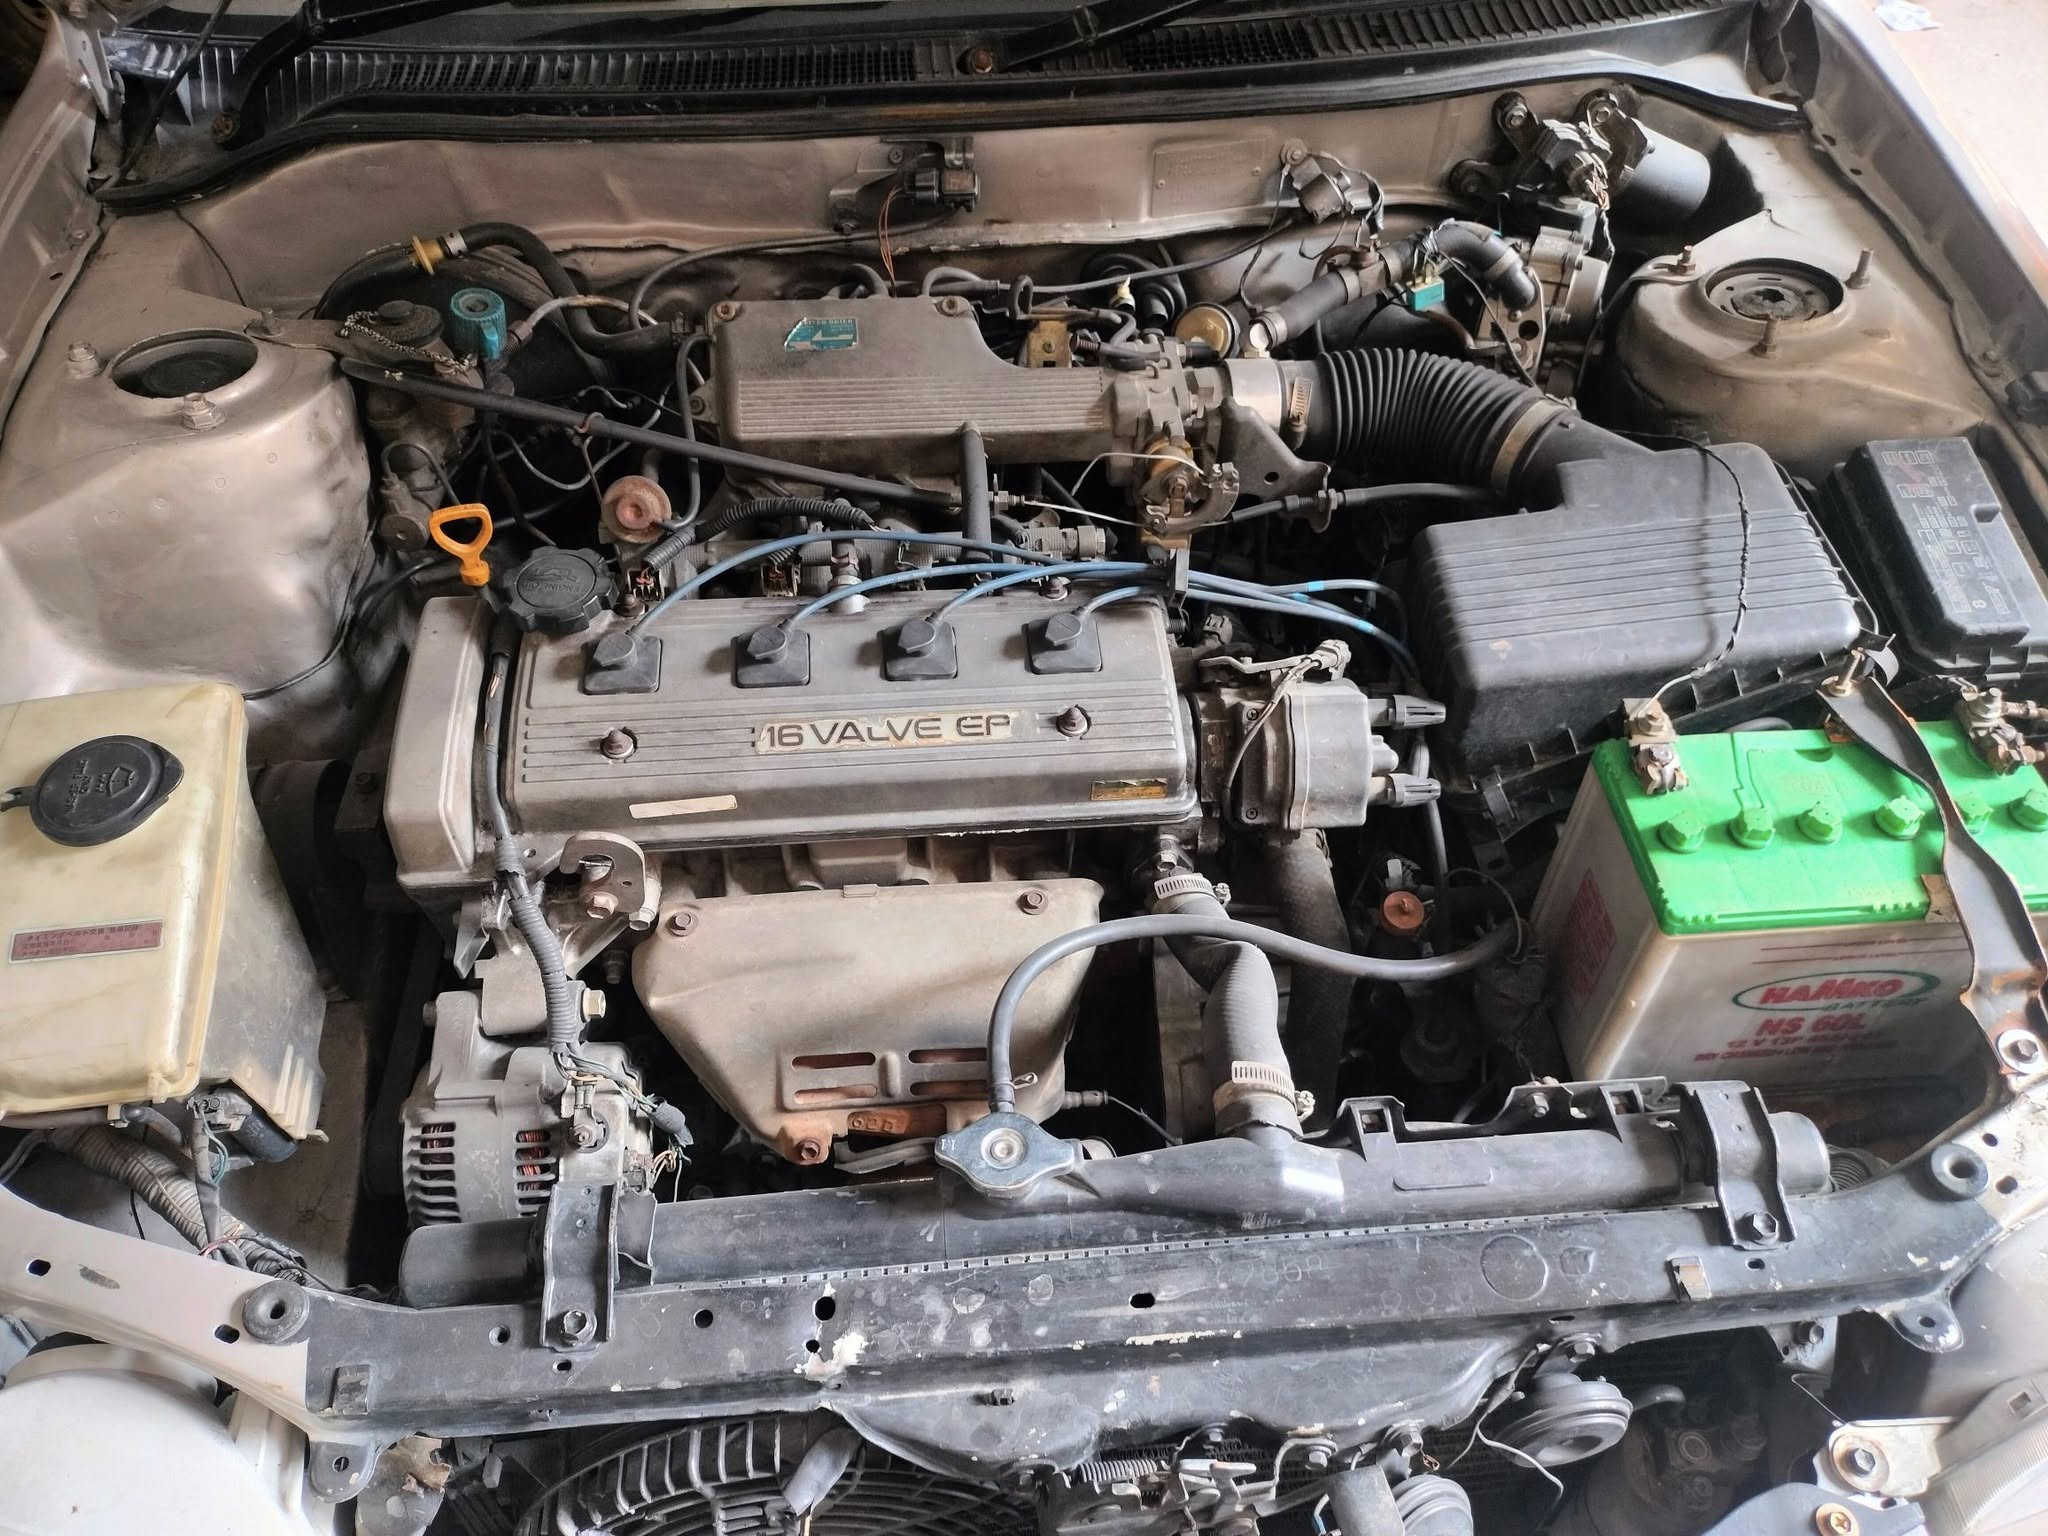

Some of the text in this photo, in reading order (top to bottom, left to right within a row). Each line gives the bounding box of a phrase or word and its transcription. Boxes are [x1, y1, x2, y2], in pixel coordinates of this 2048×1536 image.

[767, 724, 803, 747] 16
[810, 717, 942, 745] VALVE
[1759, 978, 1905, 1005] HAMKO
[1755, 1017, 1805, 1037] NS
[1810, 1013, 1867, 1033] 60L
